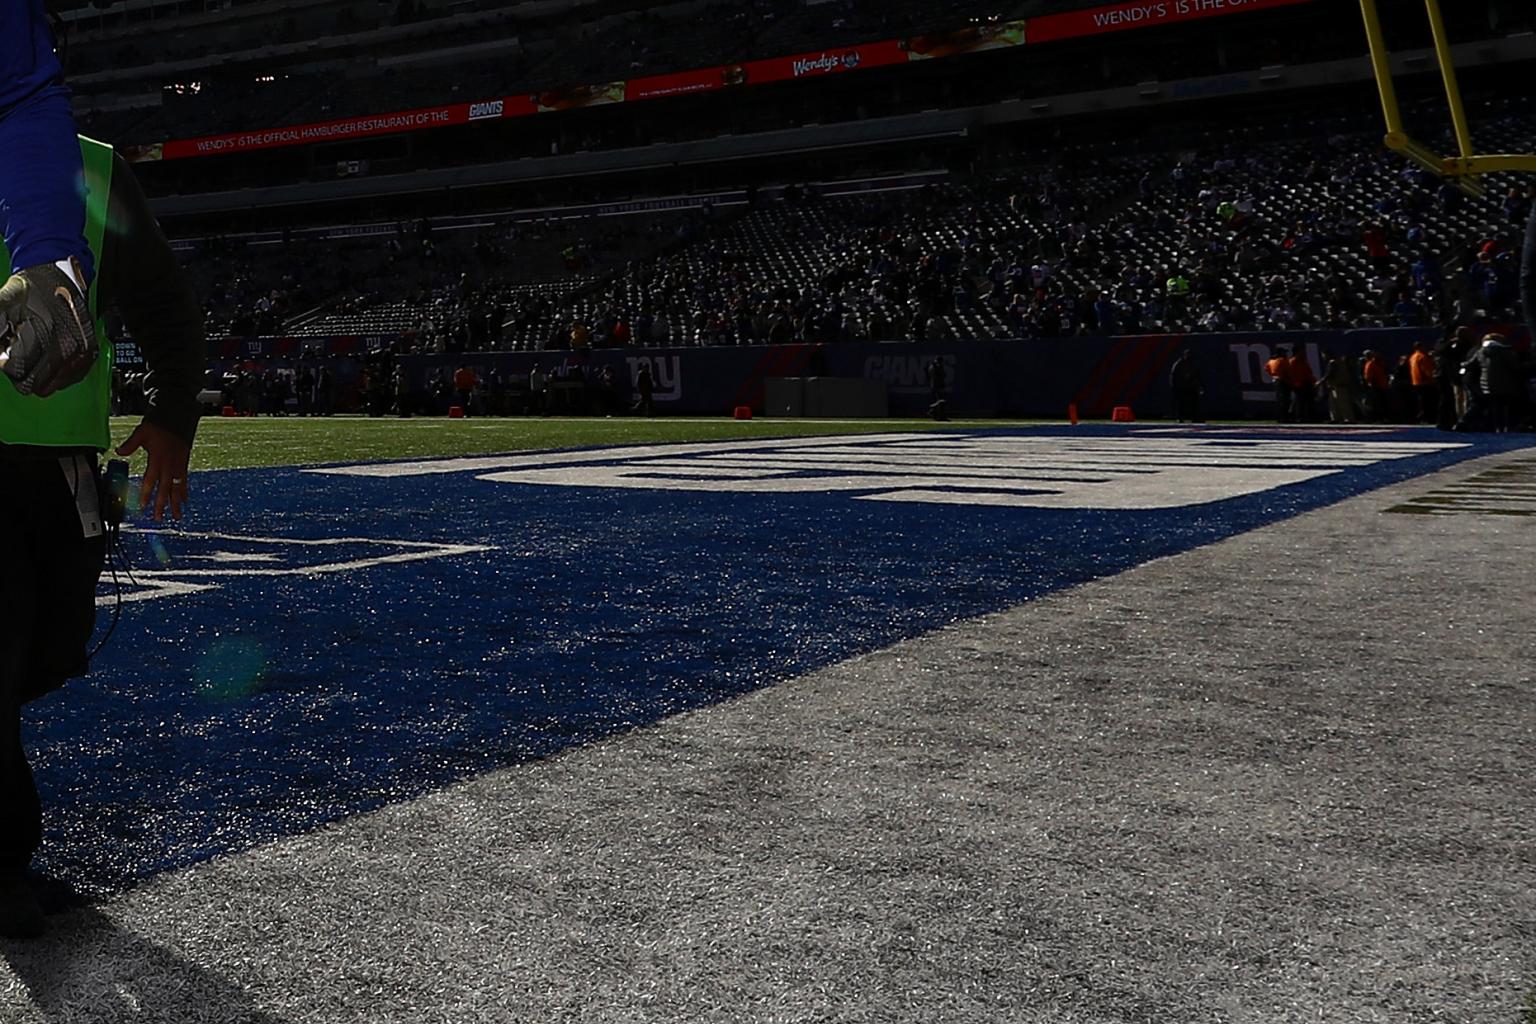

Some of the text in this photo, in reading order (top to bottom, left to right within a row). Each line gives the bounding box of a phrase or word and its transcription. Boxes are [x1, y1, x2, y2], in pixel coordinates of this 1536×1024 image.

[1092, 2, 1167, 27] WENDY'S
[1175, 0, 1189, 14] IS
[793, 53, 839, 77] Wendy's
[430, 109, 449, 122] THE
[468, 100, 504, 119] GIANTS
[865, 354, 956, 394] GIANS
